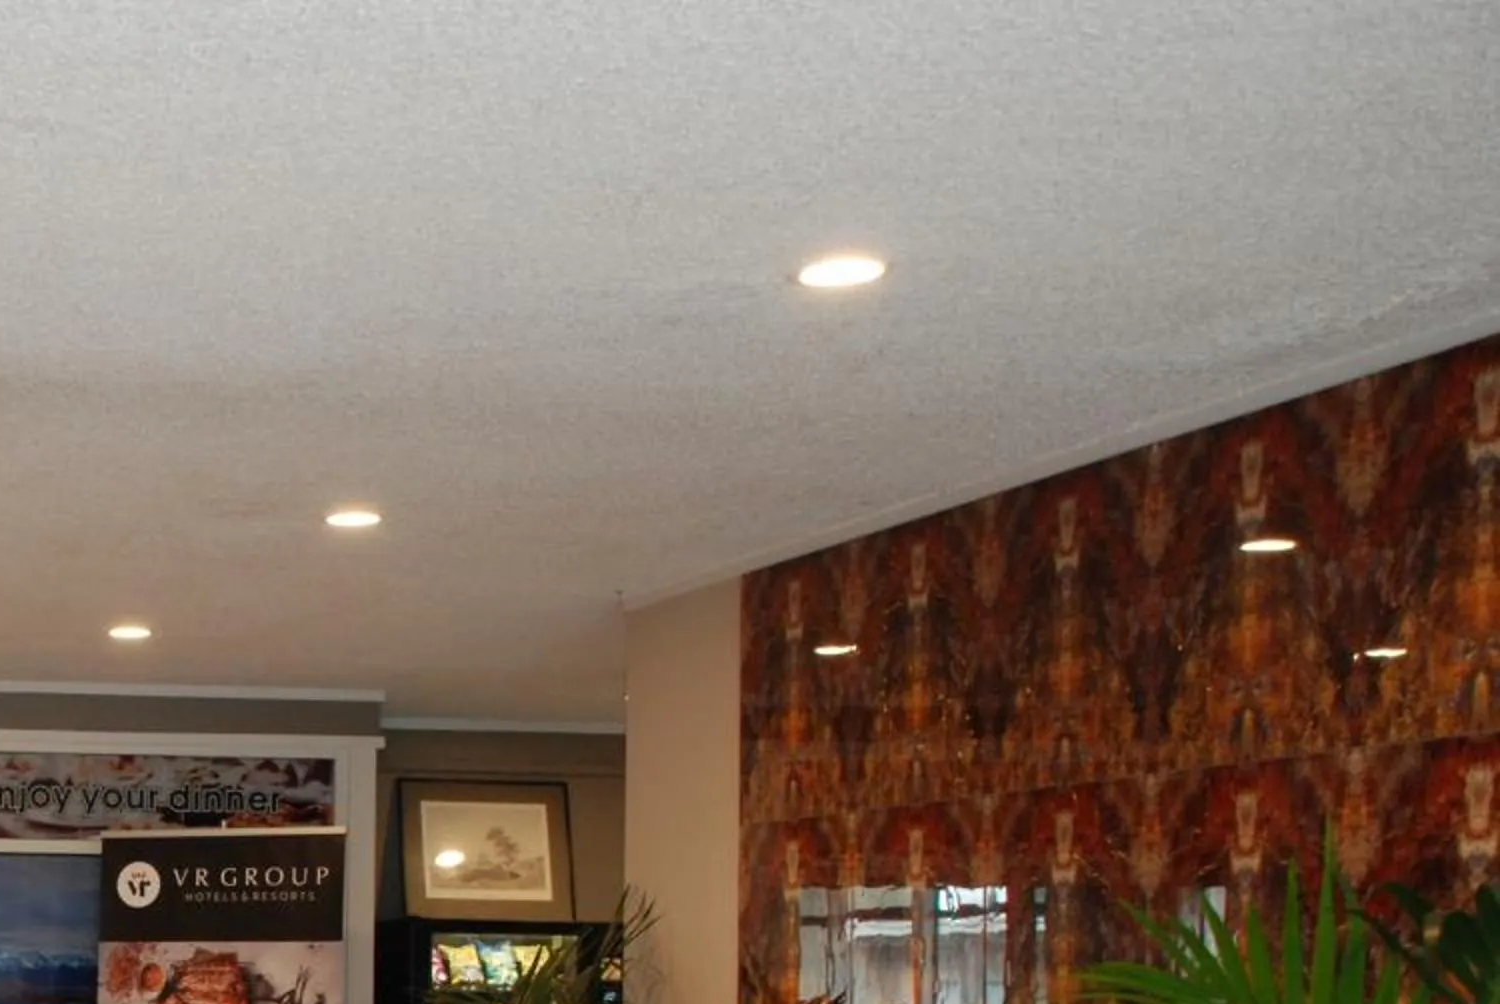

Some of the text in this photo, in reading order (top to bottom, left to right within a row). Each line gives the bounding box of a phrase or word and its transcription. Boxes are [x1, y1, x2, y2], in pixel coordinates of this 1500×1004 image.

[83, 785, 158, 814] your
[169, 783, 281, 813] dinner
[172, 866, 330, 887] VR GROUP
